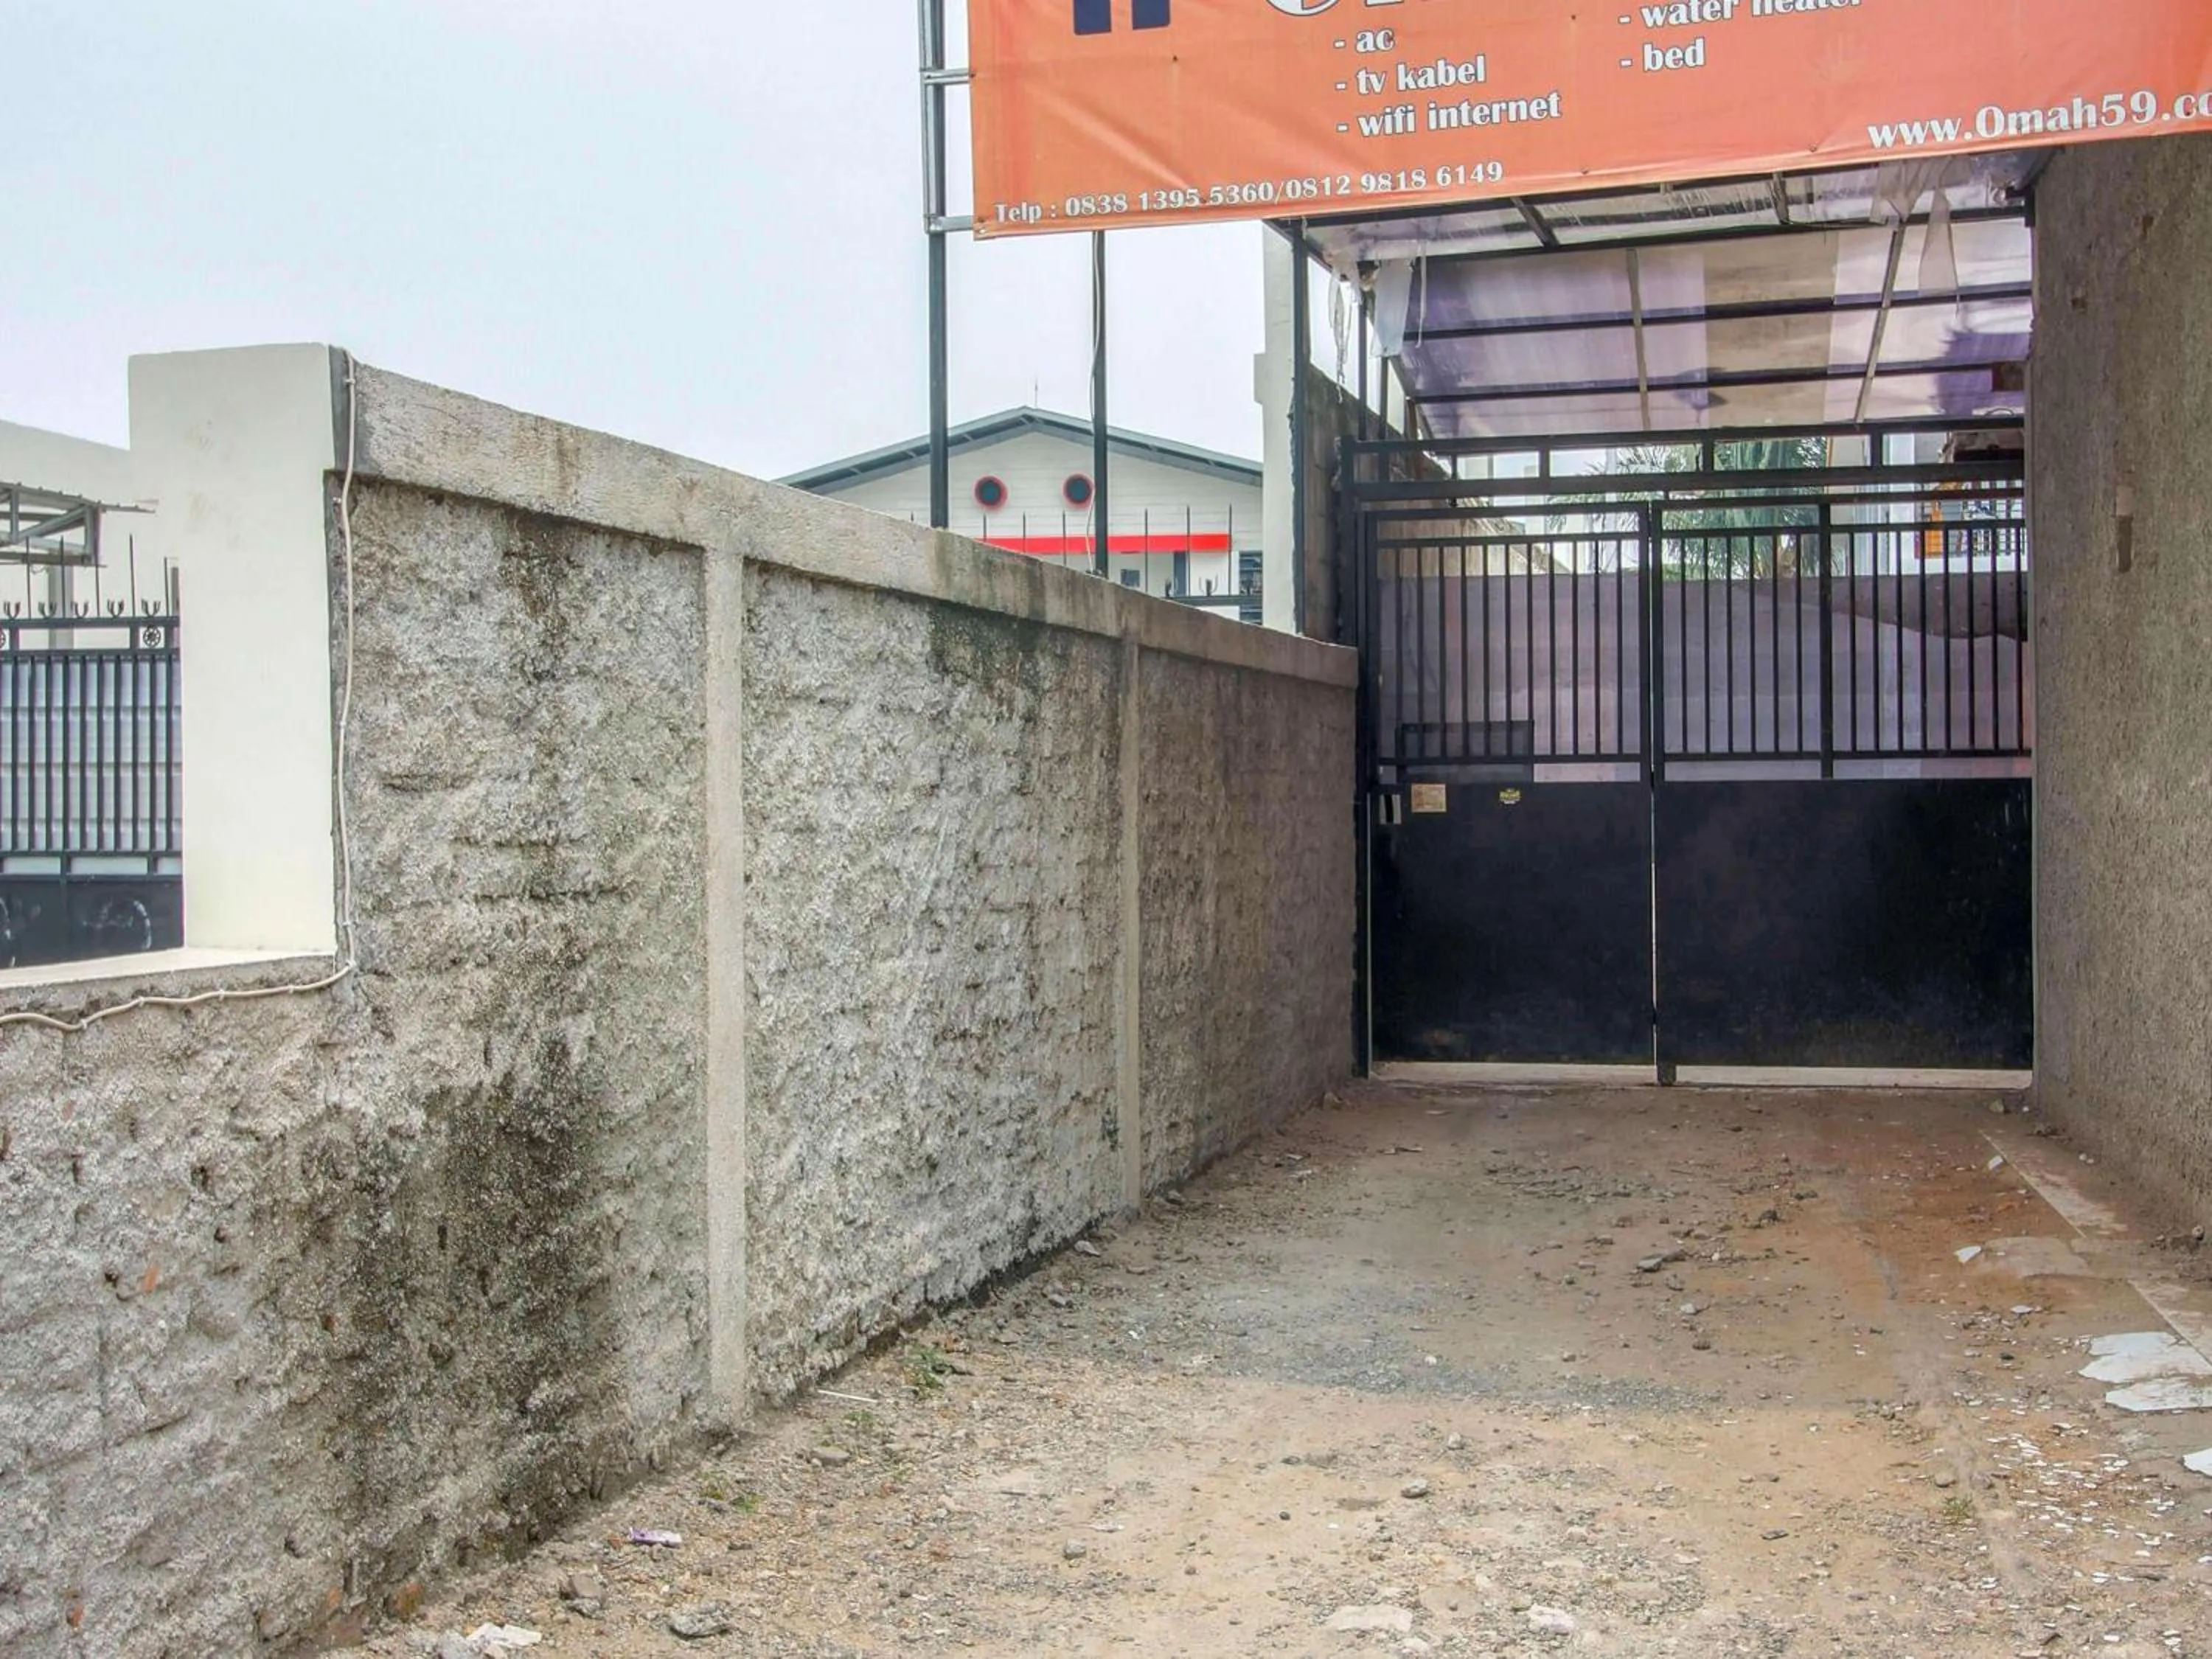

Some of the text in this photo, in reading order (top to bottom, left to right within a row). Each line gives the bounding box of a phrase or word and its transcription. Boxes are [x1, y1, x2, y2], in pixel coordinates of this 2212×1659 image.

[1641, 0, 1733, 28] water
[1355, 27, 1395, 53] ac
[1643, 38, 1705, 72] bed
[1357, 67, 1386, 94] tv
[1397, 53, 1486, 91] kabel
[1357, 105, 1416, 137] wifi
[1427, 90, 1562, 131] internet
[995, 201, 1042, 223] Telp
[1064, 192, 1127, 217] 0838
[1138, 187, 1200, 212] 1395
[1208, 174, 1351, 205] 5360/0812
[1360, 168, 1426, 194] 9818
[1436, 161, 1503, 188] 6149
